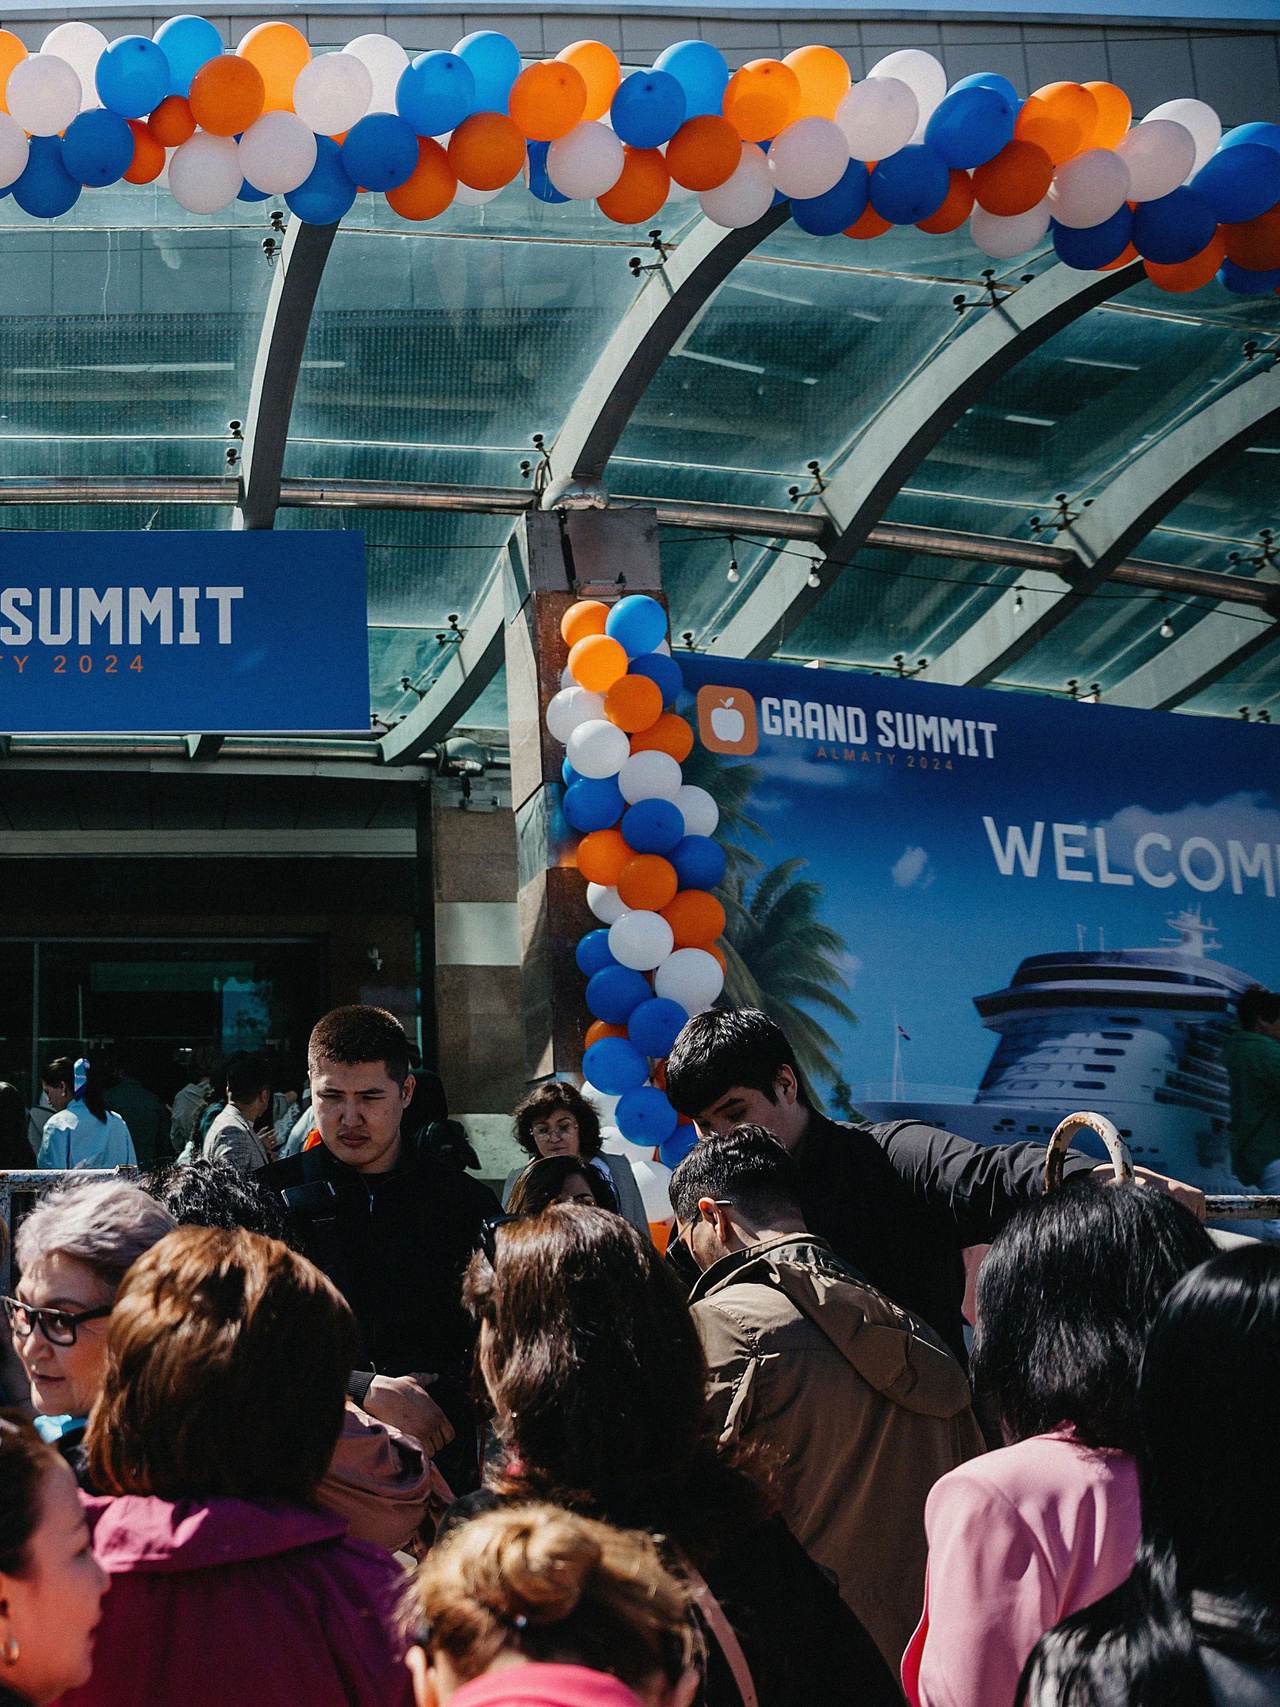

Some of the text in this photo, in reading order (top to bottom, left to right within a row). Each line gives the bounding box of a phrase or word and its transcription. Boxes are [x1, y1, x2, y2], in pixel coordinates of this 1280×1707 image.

[0, 586, 244, 645] SUMMIT
[53, 654, 144, 674] 2024
[761, 697, 998, 759] GRAND SUMMIT
[817, 746, 954, 771] ALMATY 2024
[982, 815, 1280, 898] WELCOM
